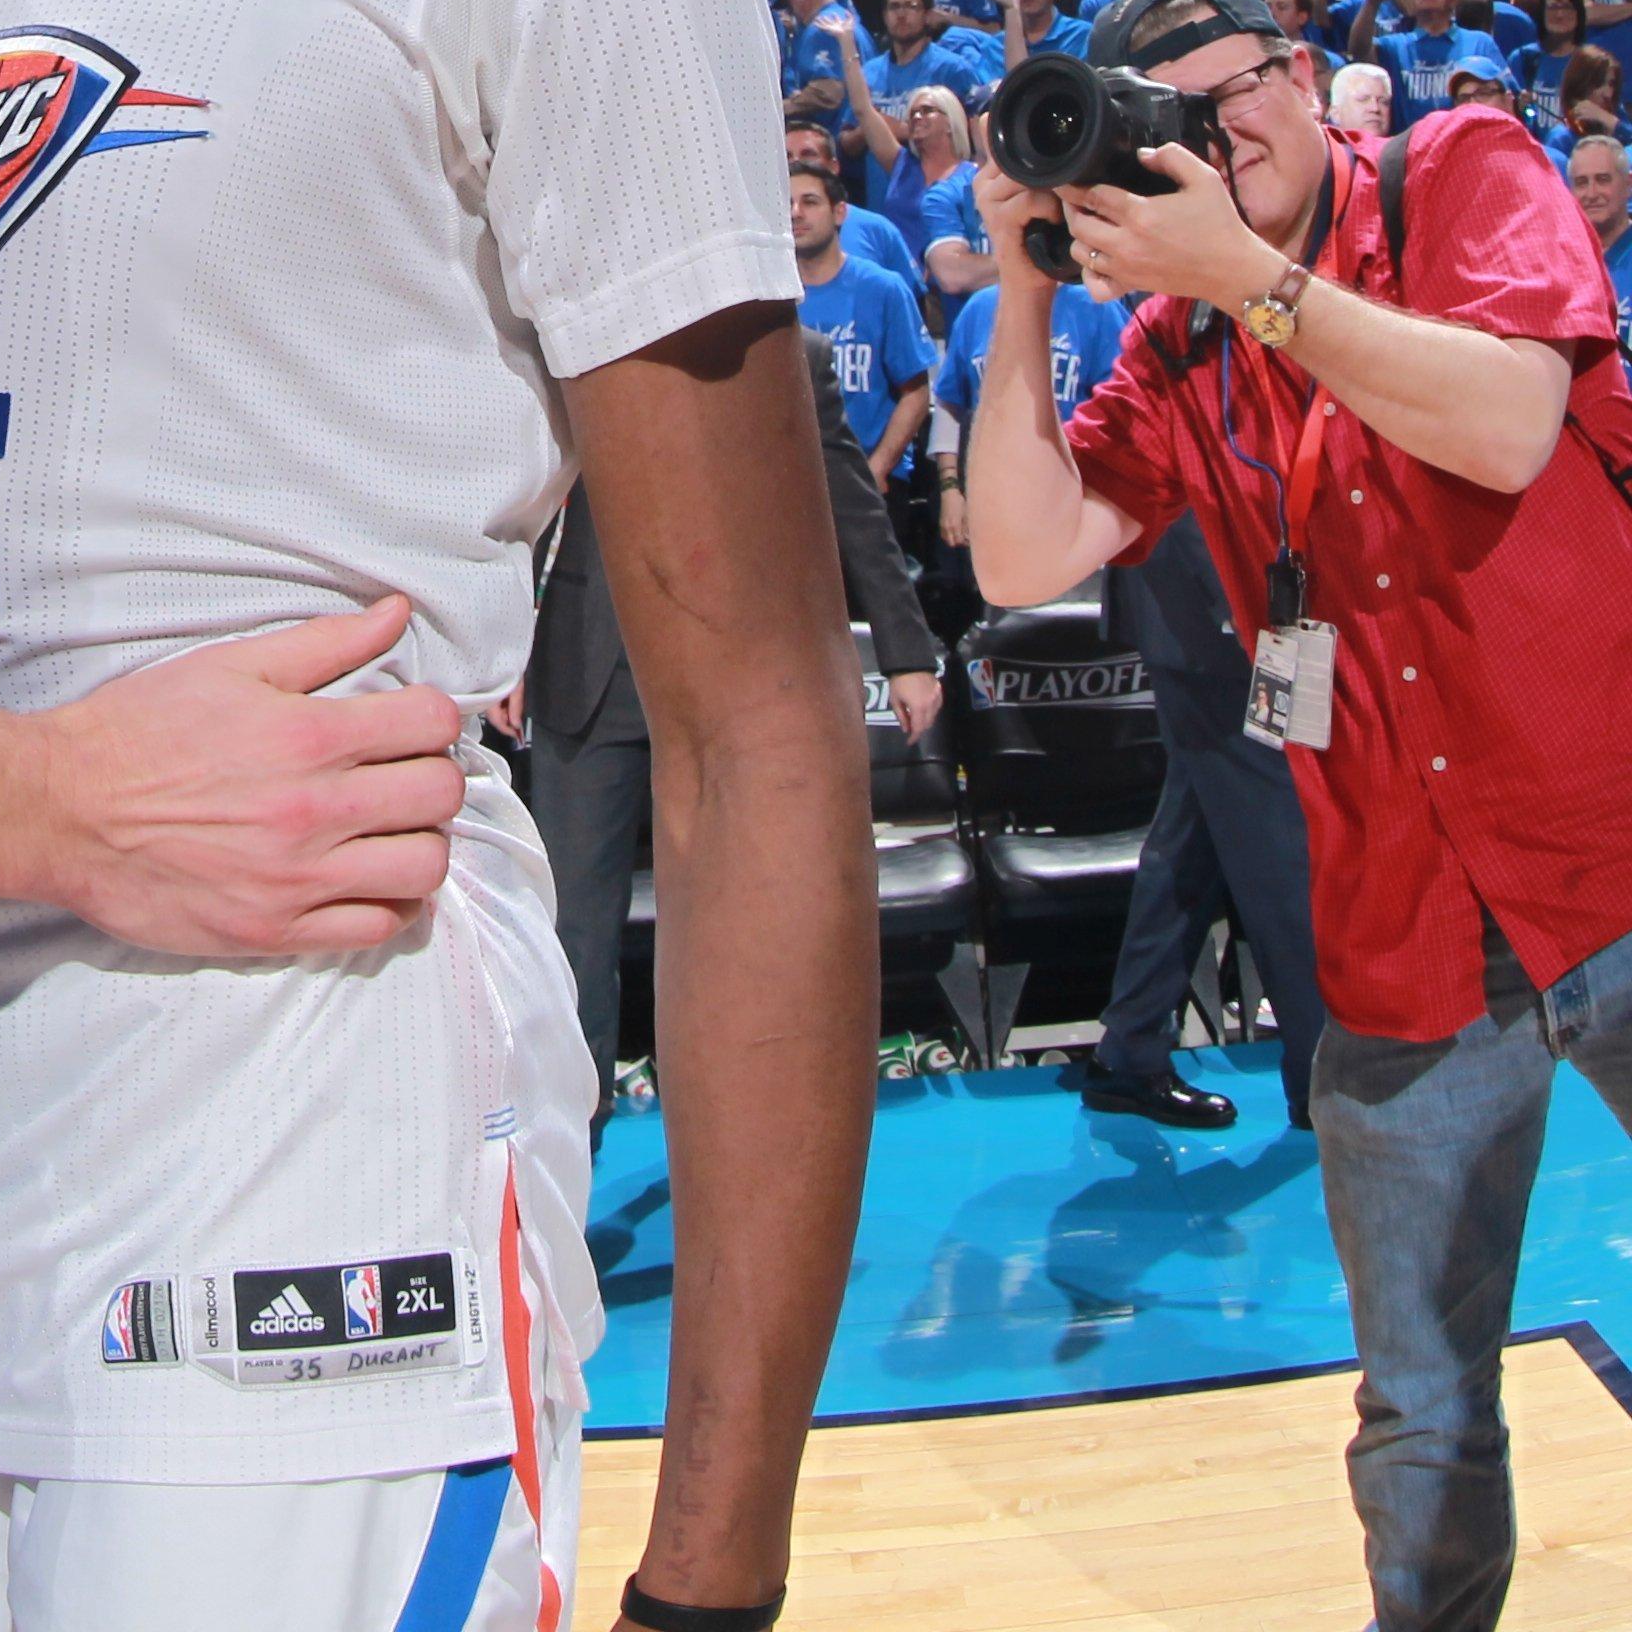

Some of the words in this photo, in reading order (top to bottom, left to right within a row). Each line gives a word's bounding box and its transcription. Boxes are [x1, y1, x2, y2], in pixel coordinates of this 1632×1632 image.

[202, 1275, 220, 1348] climacool
[395, 1286, 445, 1316] 2XL
[467, 1290, 483, 1344] LENGTH
[249, 1314, 326, 1336] adidas
[284, 1356, 322, 1381] 35
[347, 1337, 448, 1372] DURANT
